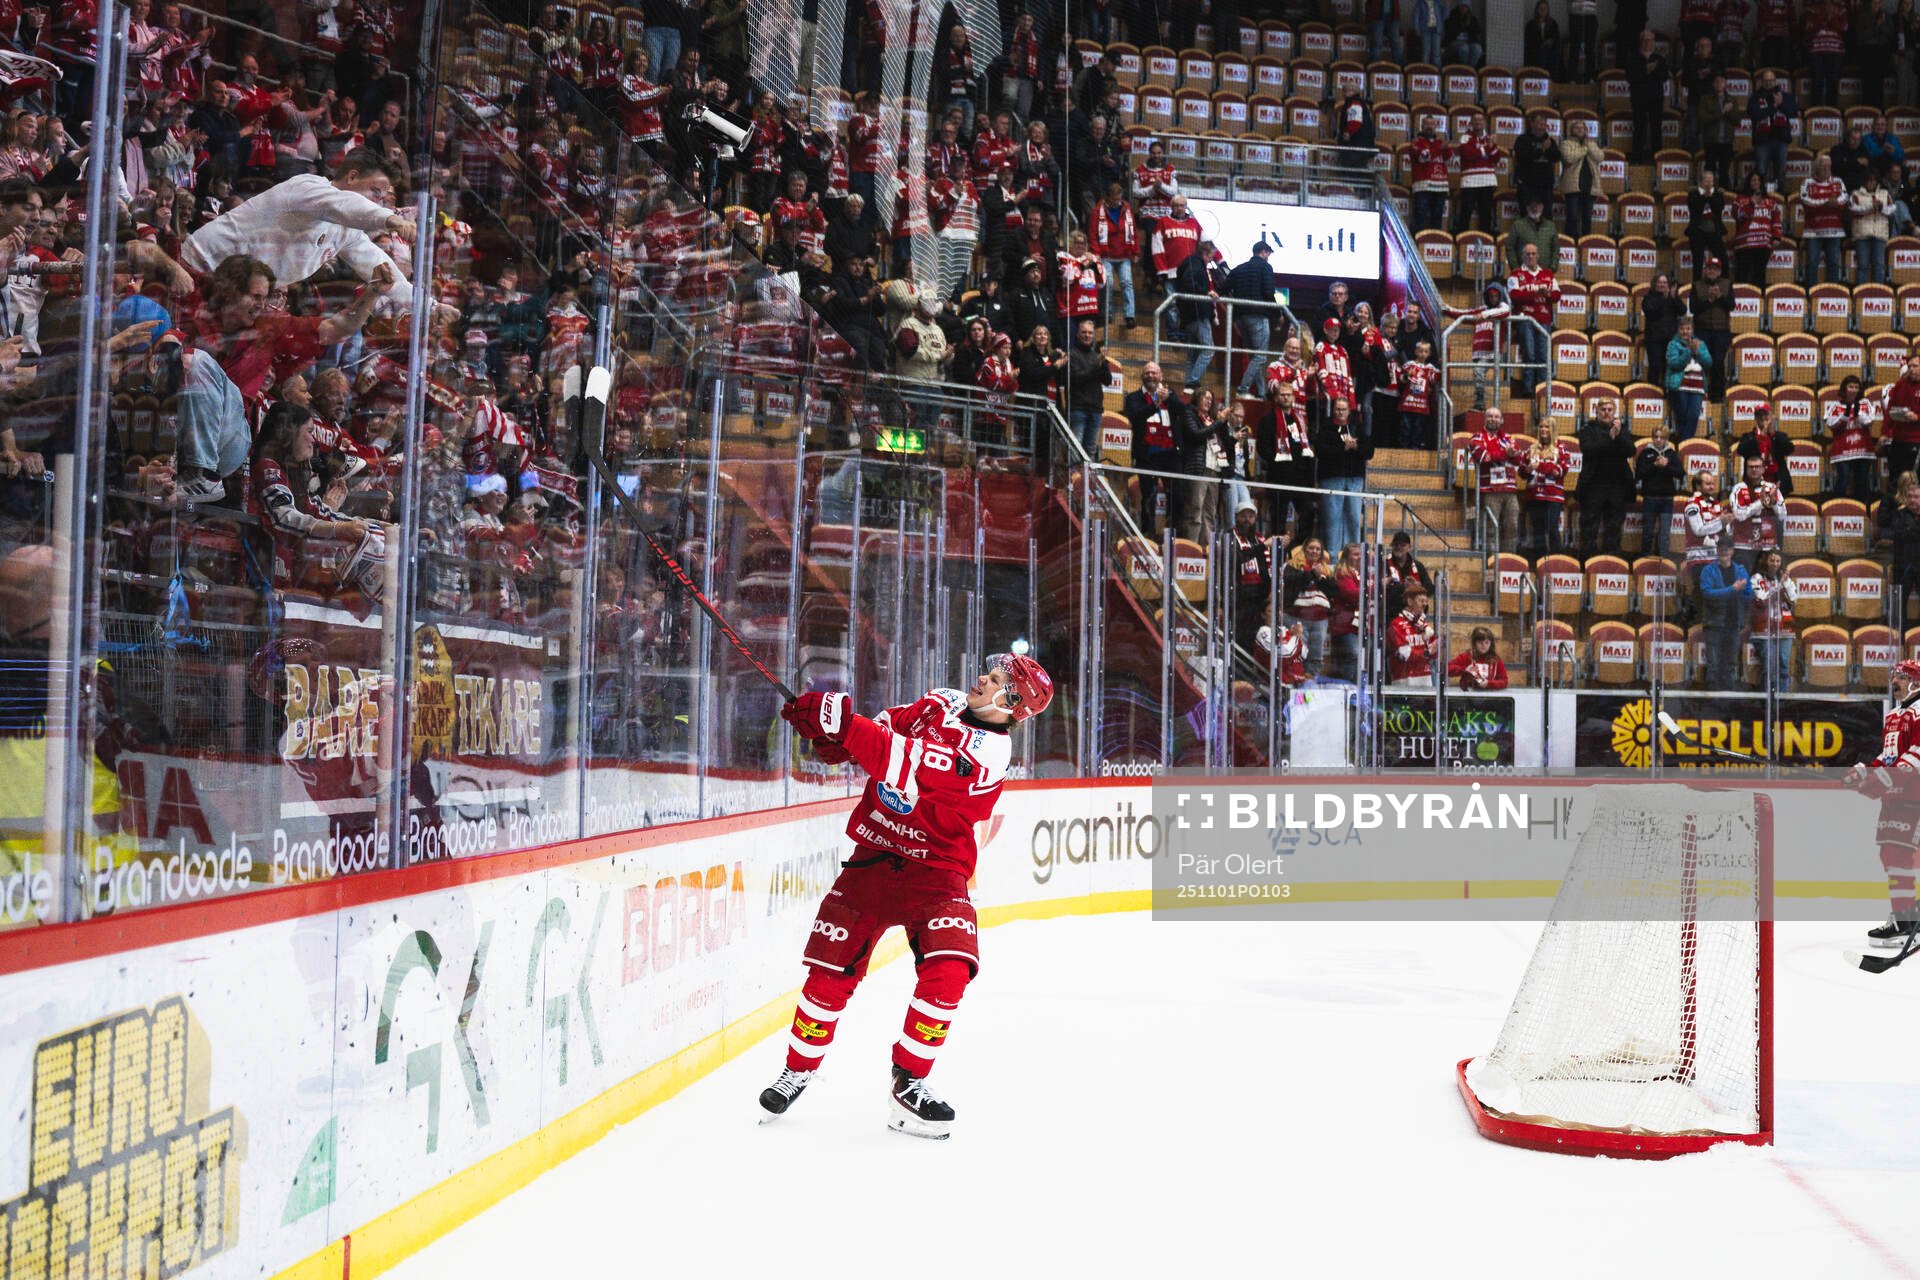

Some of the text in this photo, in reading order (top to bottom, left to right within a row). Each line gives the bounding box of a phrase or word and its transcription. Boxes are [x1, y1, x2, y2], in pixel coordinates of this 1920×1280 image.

[1560, 300, 1583, 308] MAXI
[1600, 300, 1624, 309] MAXI
[1776, 304, 1802, 312] MAXI
[1821, 303, 1846, 312] MAXI
[1865, 303, 1889, 312] MAXI
[1560, 349, 1585, 358] MAXI
[1602, 351, 1627, 360] MAXI
[1744, 353, 1770, 361] MAXI
[1790, 353, 1815, 361] MAXI
[1834, 353, 1859, 361] MAXI
[1636, 404, 1661, 413] MAXI
[1782, 406, 1808, 415] MAXI
[1105, 433, 1130, 442] MAXI
[1688, 460, 1719, 474] MAXI
[1789, 462, 1817, 470] MAXI
[1786, 521, 1814, 530] MAXI
[1834, 521, 1862, 530] MAXI
[1178, 563, 1204, 573] MAXI
[1554, 578, 1580, 587] MAXI
[1599, 579, 1626, 589] MAXI
[1800, 583, 1828, 593] MAXI
[1850, 583, 1879, 593] MAXI
[1602, 647, 1631, 657] MAXI
[1814, 650, 1844, 659] MAXI
[1398, 736, 1478, 760] HUET
[923, 743, 954, 772] 18
[410, 805, 498, 864] Brandcode
[1032, 802, 1178, 885] granitor
[273, 818, 391, 885] Brandcode
[94, 831, 252, 917] Brandcode
[621, 861, 748, 988] BORGA
[928, 916, 977, 935] coop
[33, 1004, 186, 1188] EURO
[0, 1118, 232, 1280] ACKPOT
